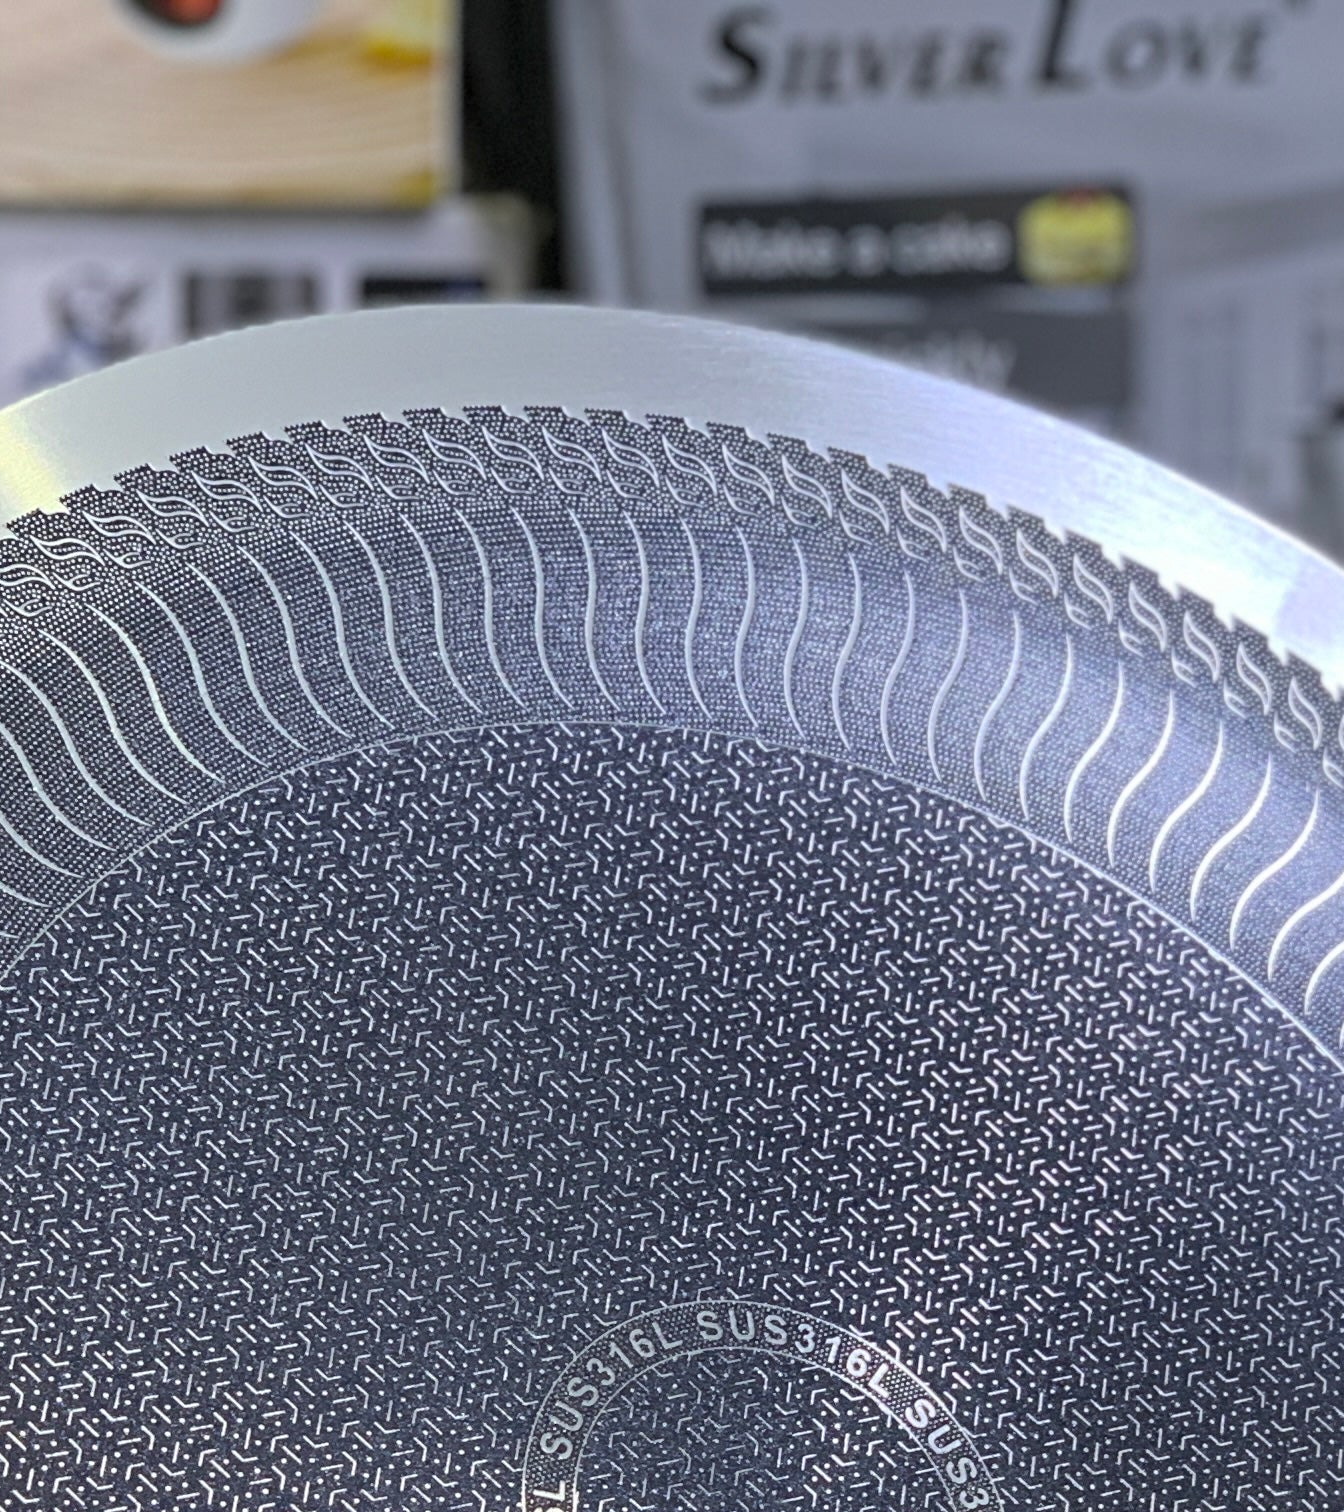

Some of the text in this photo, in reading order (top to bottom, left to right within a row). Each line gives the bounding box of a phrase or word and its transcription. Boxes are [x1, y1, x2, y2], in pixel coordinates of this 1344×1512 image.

[696, 4, 1008, 105] SILVER
[541, 1321, 684, 1460] SUS316L
[697, 1309, 891, 1399] SUS316L
